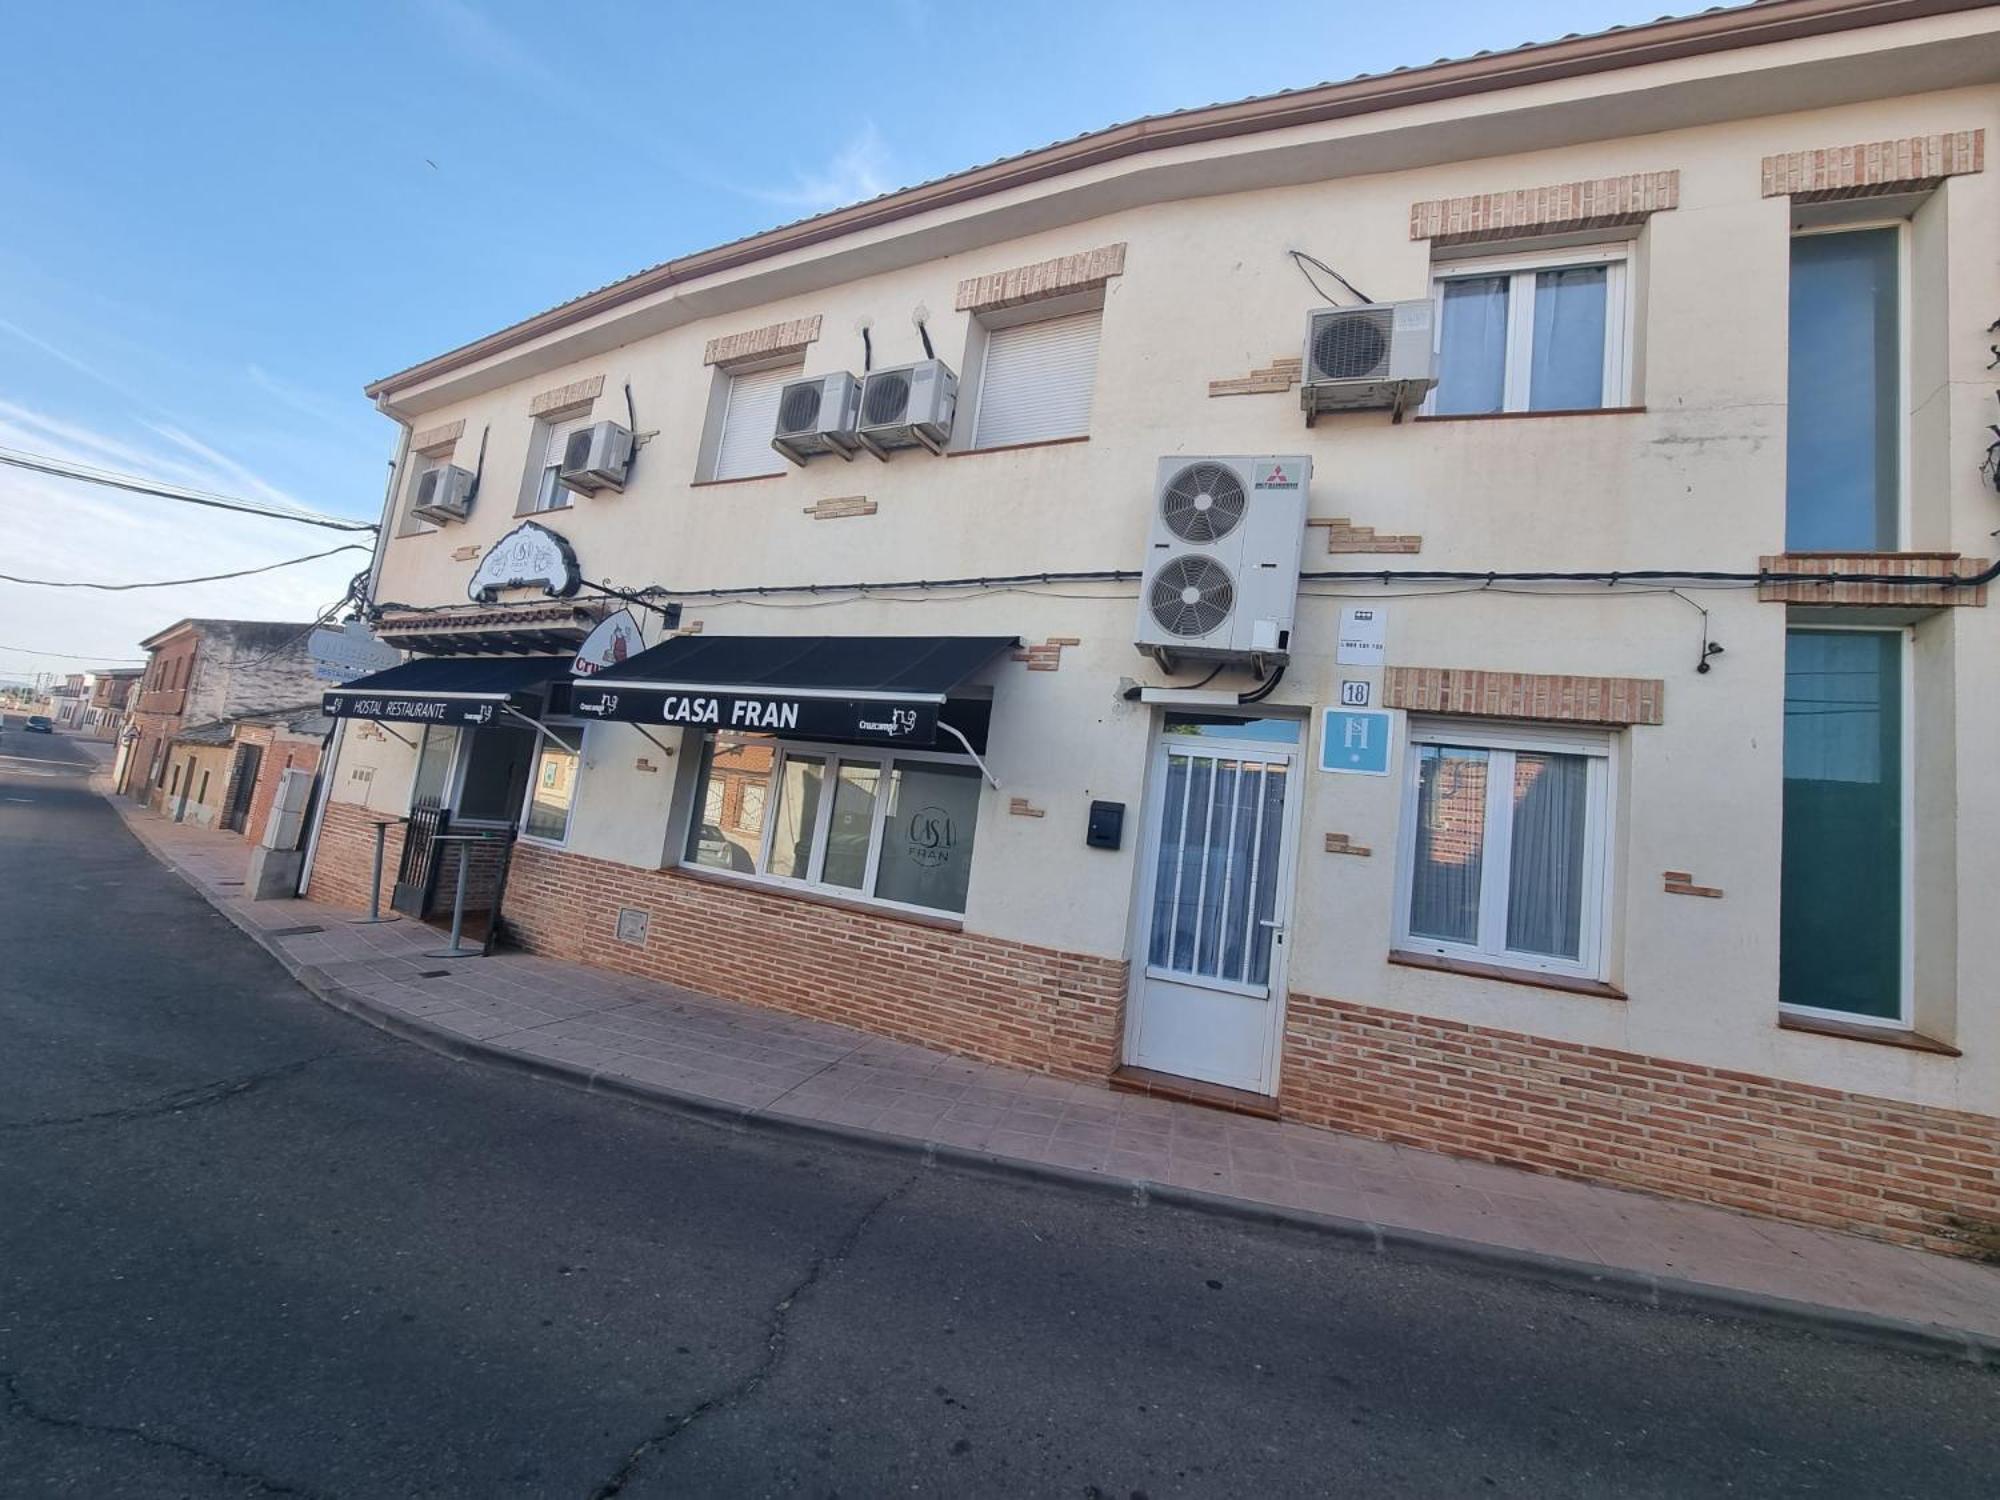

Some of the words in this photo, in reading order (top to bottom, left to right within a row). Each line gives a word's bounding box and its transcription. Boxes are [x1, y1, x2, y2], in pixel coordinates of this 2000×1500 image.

[1347, 684, 1364, 702] 18
[353, 700, 382, 715] HOSTAL
[386, 701, 447, 719] RESTAURANTE
[663, 696, 719, 723] CASA
[731, 700, 799, 728] FRAN
[908, 847, 949, 861] FRAN
